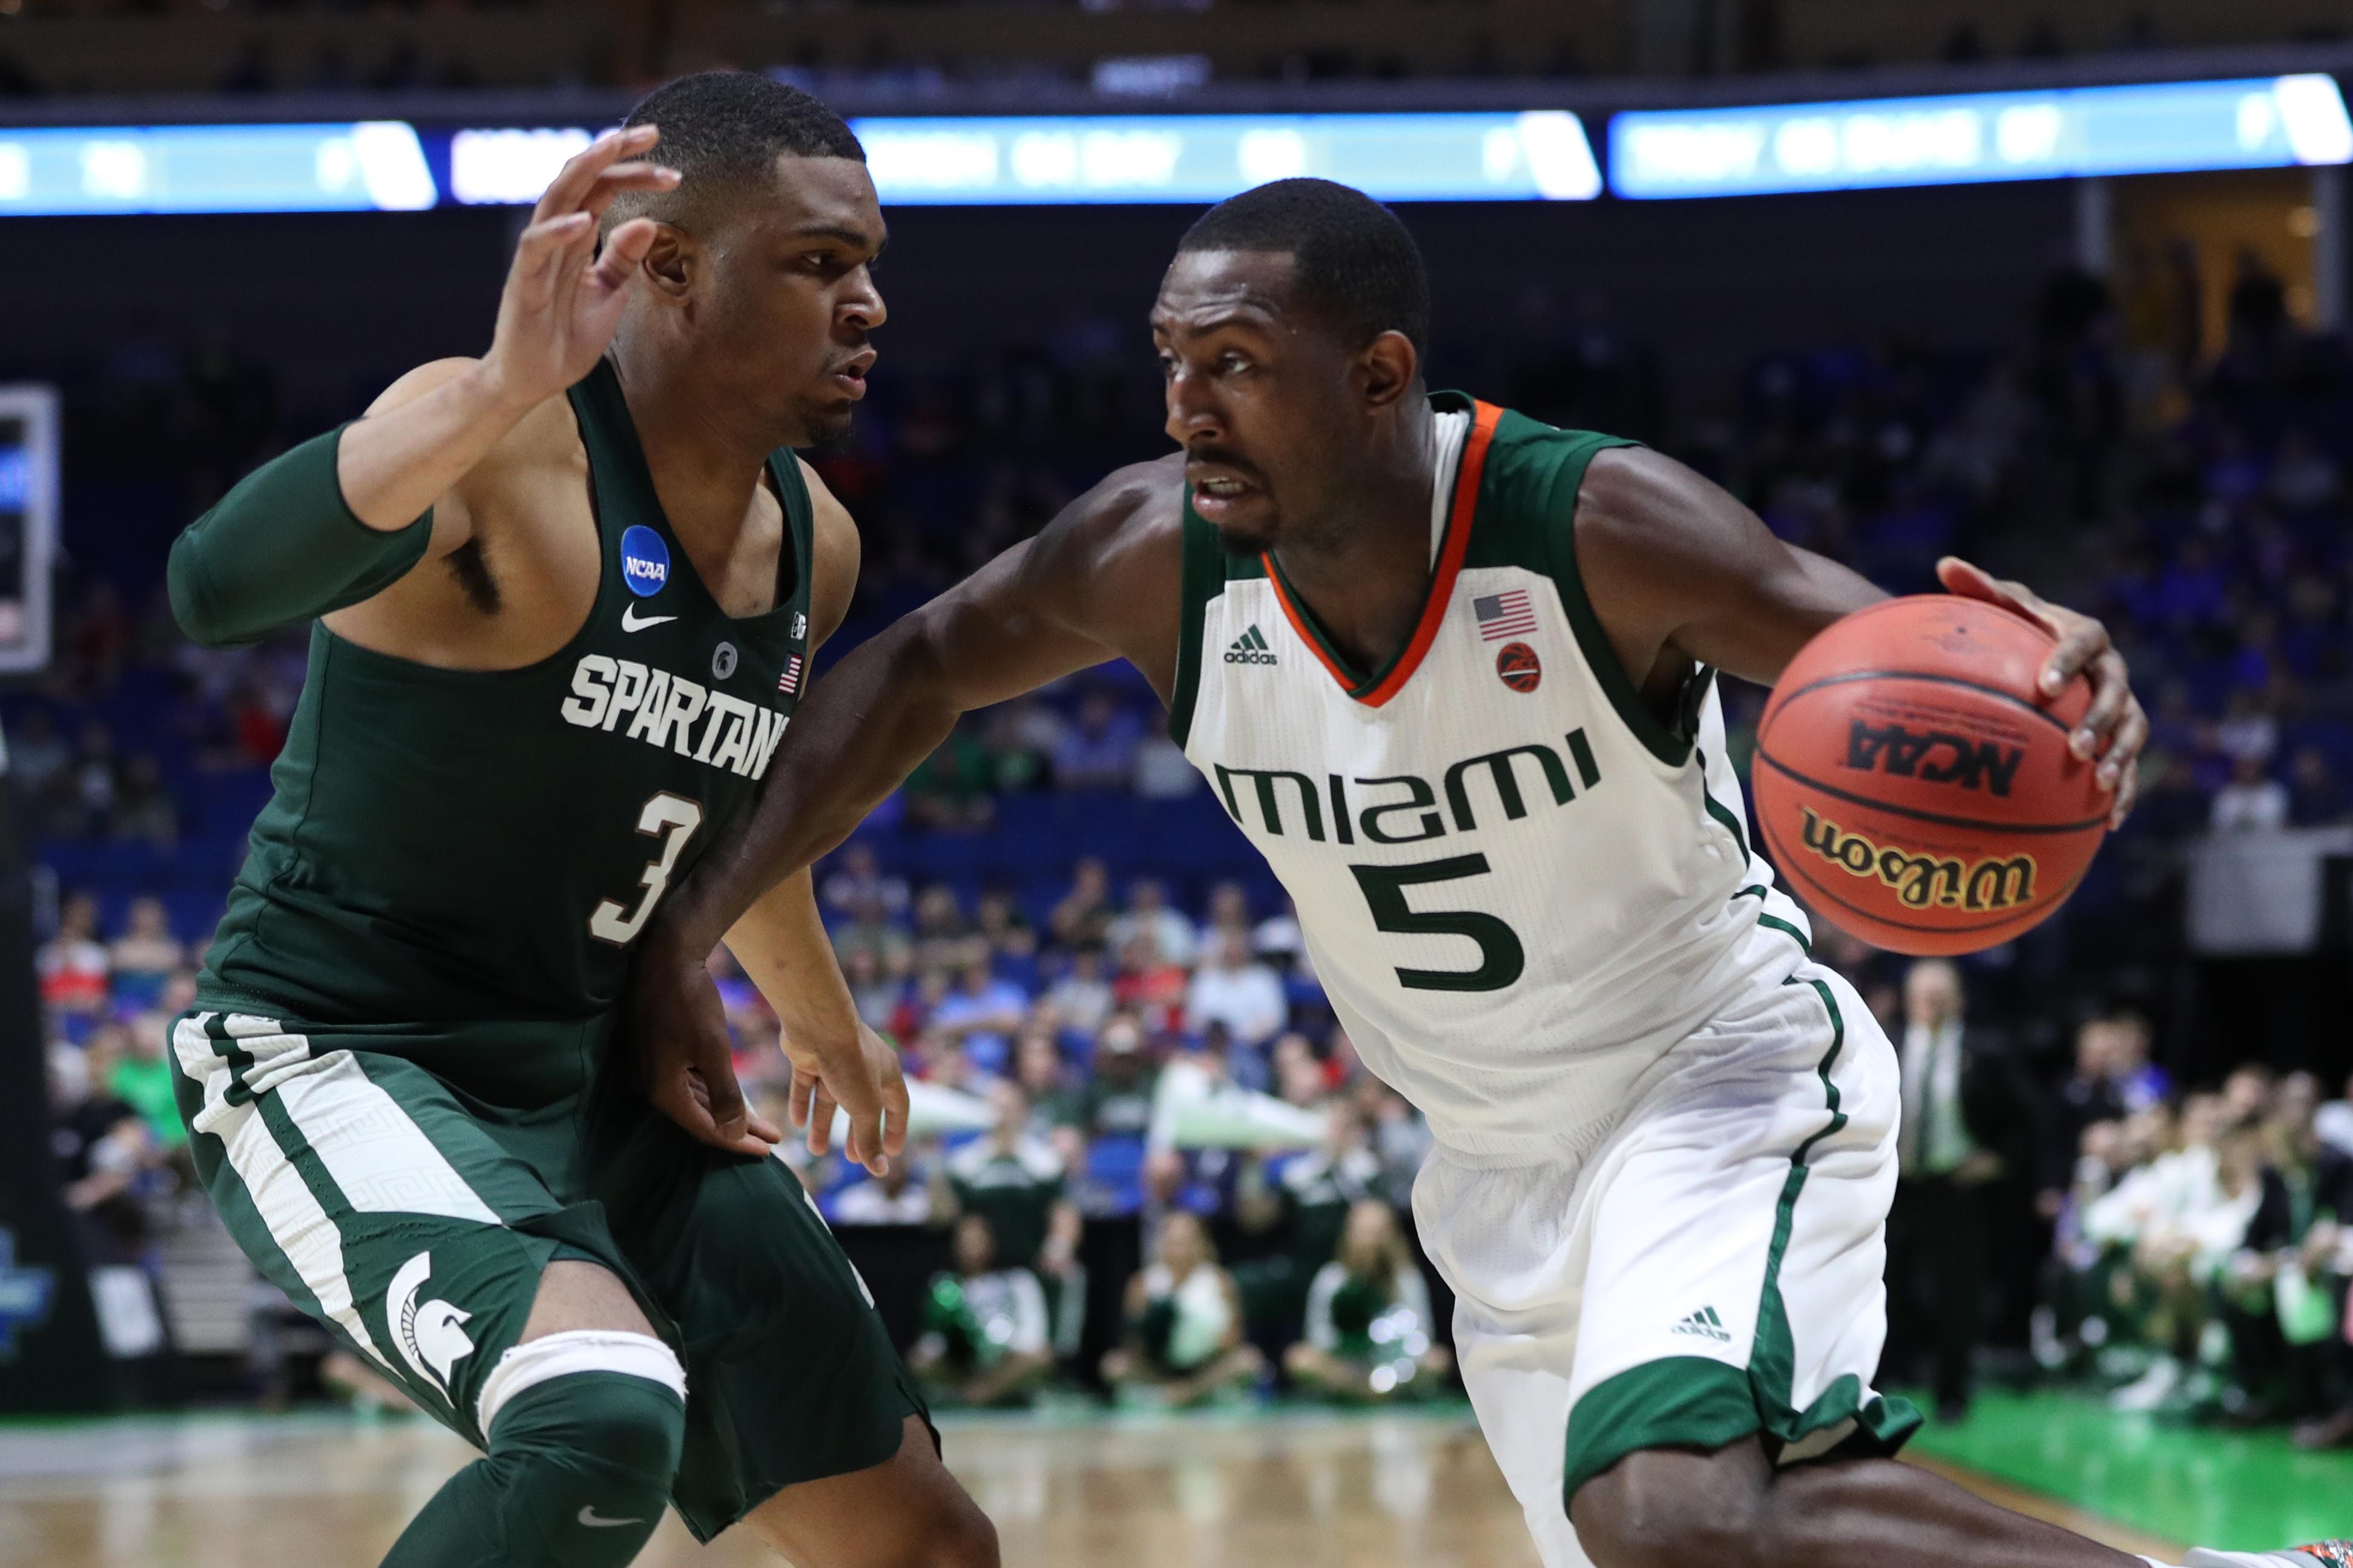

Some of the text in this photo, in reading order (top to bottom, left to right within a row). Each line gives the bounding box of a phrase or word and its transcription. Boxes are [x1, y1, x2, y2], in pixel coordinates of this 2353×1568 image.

[626, 556, 665, 581] NCAA
[1224, 649, 1277, 665] adidas
[1848, 719, 2024, 798] NCAA
[587, 790, 704, 948] 3
[1801, 807, 2037, 912] Wilson
[1348, 852, 1525, 992] 5
